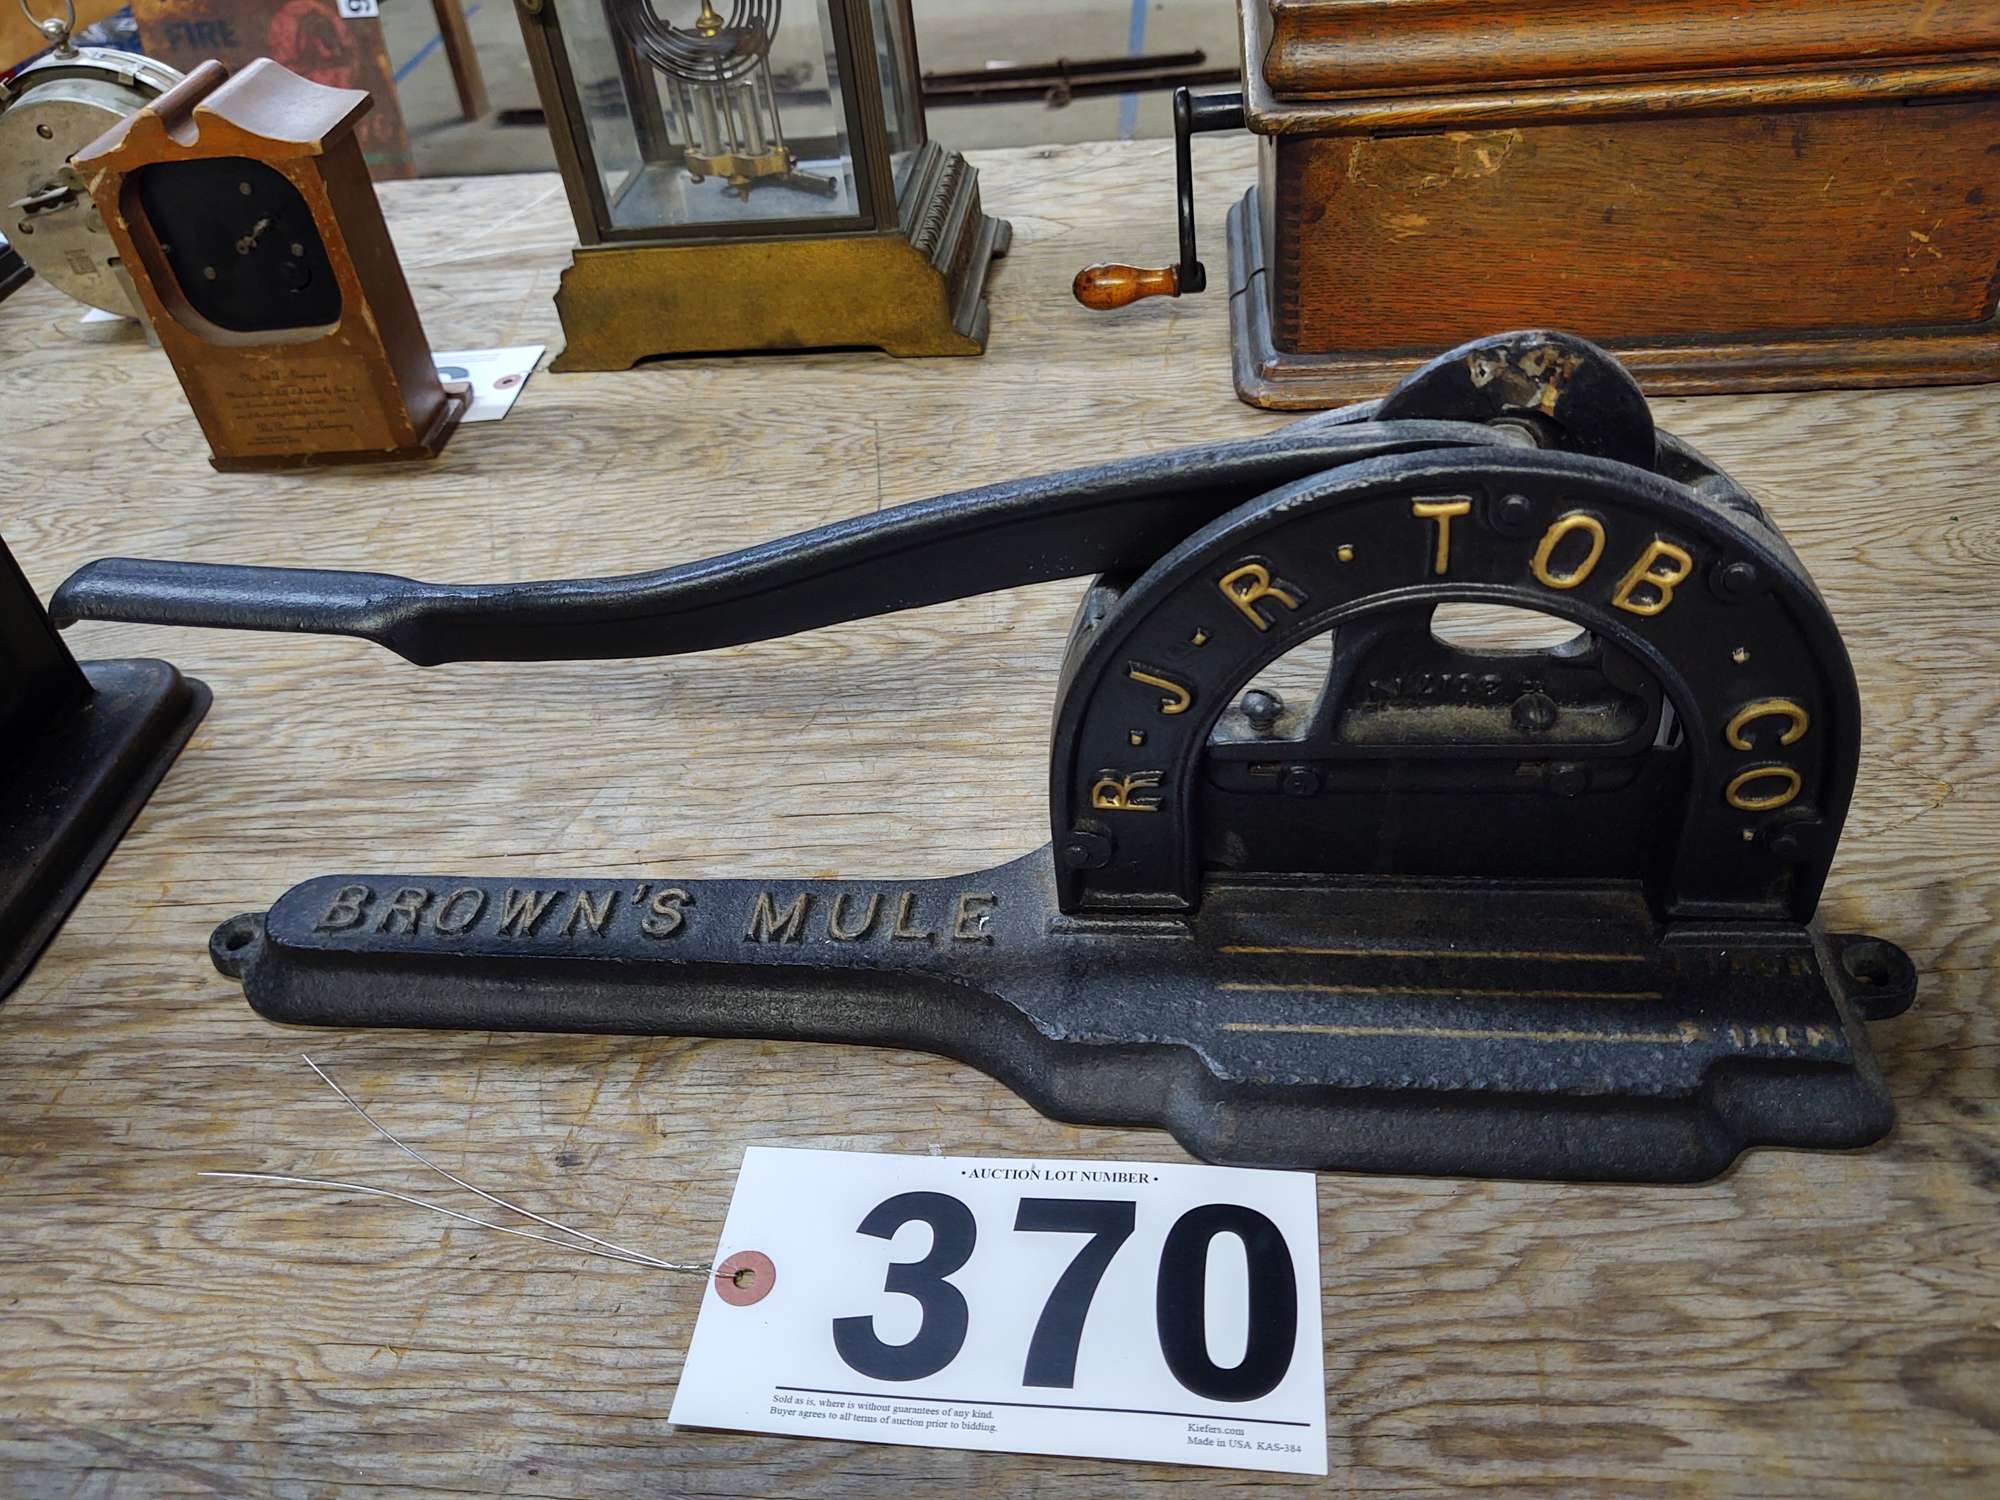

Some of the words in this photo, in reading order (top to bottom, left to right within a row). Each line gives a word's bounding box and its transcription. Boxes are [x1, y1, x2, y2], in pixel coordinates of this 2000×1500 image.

[312, 883, 697, 942] BROWN'S
[743, 889, 999, 946] MULE
[968, 1168, 1041, 1181] AUCTION
[1045, 1170, 1078, 1182] LOT
[1080, 1171, 1150, 1184] NUMBER
[832, 1190, 1298, 1403] 370
[773, 1394, 793, 1405] Sold
[795, 1397, 804, 1405] as
[818, 1399, 846, 1409] where
[847, 1400, 855, 1409] is
[857, 1401, 891, 1412] without
[892, 1404, 939, 1416] guarantees
[941, 1405, 952, 1416] of
[953, 1409, 970, 1419] any
[971, 1407, 994, 1419] kind.
[770, 1406, 796, 1417] Buyer
[798, 1410, 826, 1420] agrees
[828, 1411, 838, 1420] to
[839, 1411, 852, 1421] all
[853, 1413, 878, 1423] terms
[880, 1414, 892, 1424] of
[892, 1416, 925, 1427] auction
[925, 1418, 949, 1430] prior
[950, 1420, 959, 1429] to
[961, 1420, 998, 1434] bidding.
[1187, 1423, 1245, 1436] Kiefers.com
[1187, 1436, 1214, 1446] Made
[1216, 1438, 1226, 1447] in
[1228, 1439, 1252, 1449] USA
[1256, 1441, 1302, 1453] KAS-384
